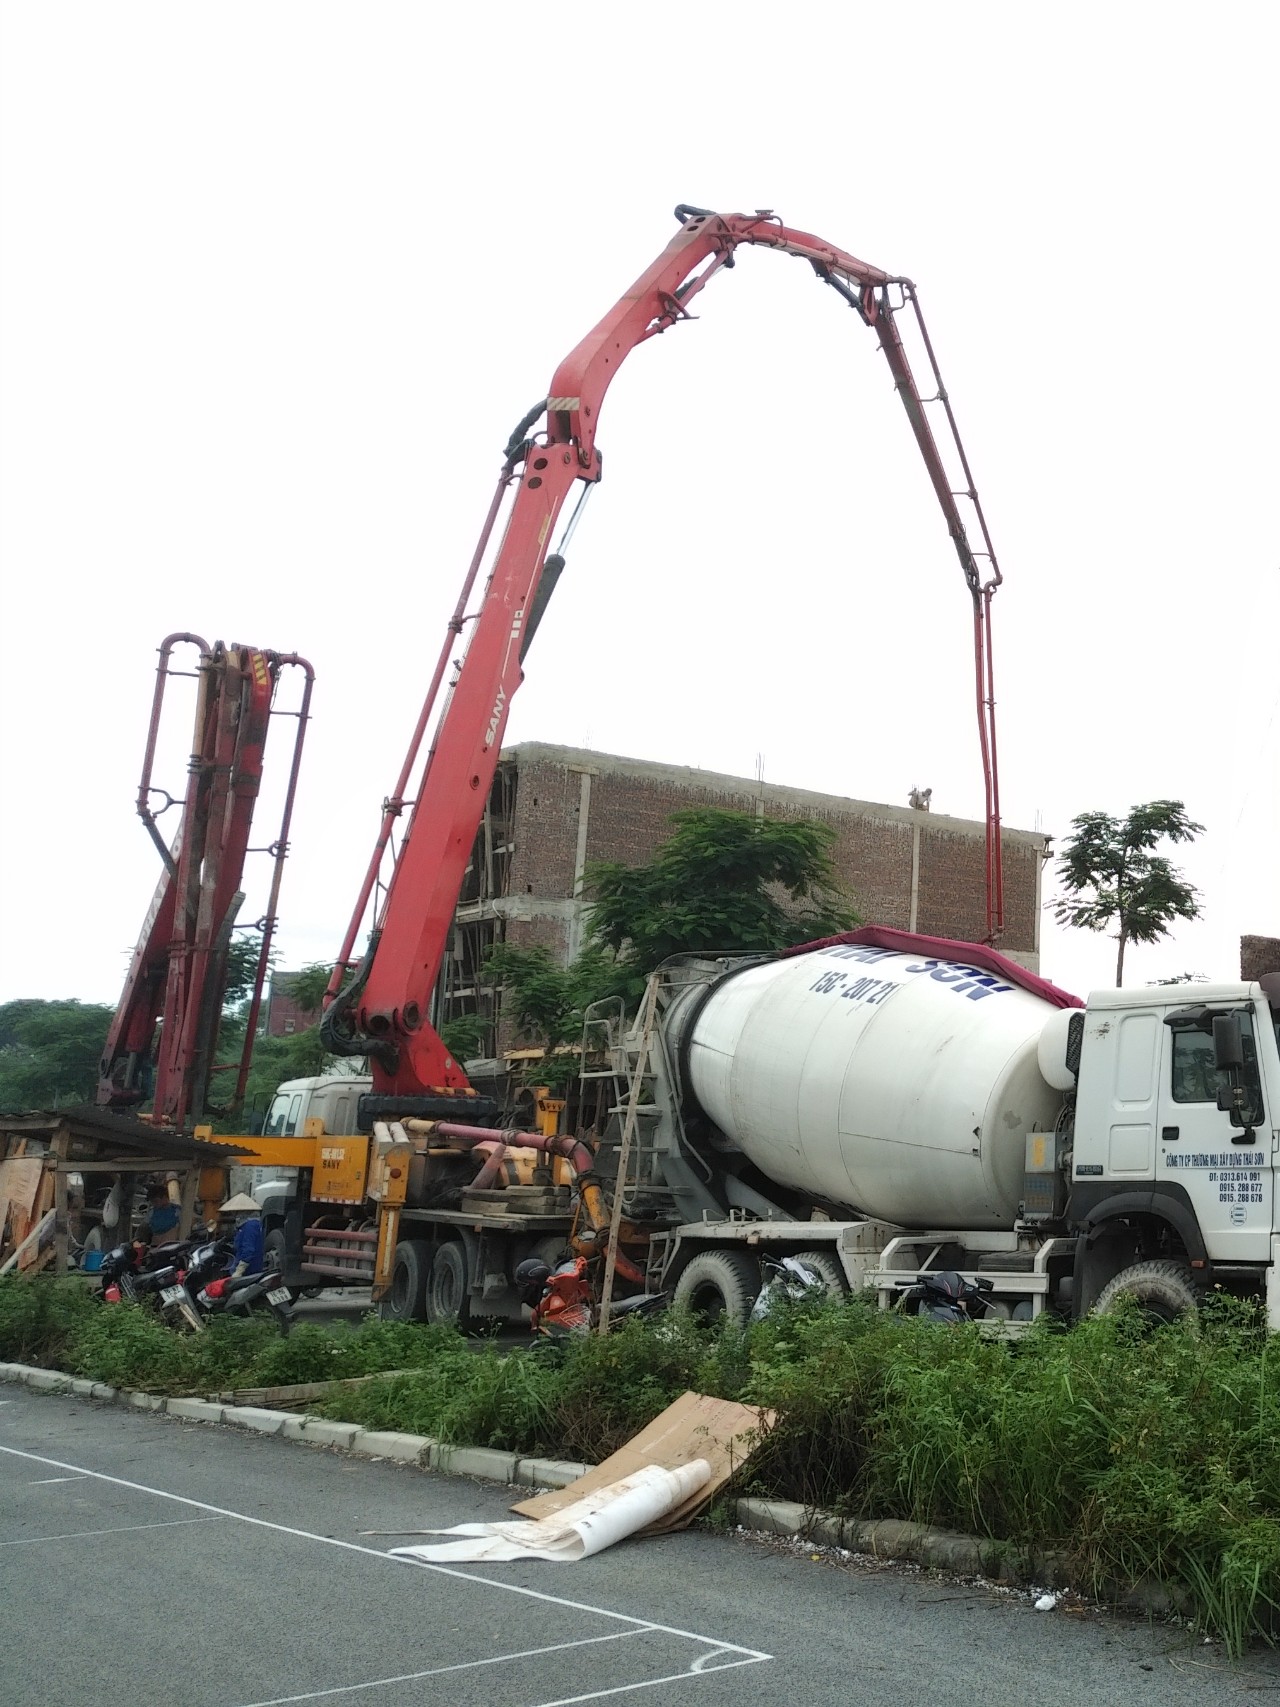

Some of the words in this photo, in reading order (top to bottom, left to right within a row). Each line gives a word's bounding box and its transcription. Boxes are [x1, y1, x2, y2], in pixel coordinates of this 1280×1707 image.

[485, 684, 507, 747] SANY
[322, 1160, 341, 1170] SANY
[1250, 1182, 1263, 1192] 677
[1250, 1193, 1263, 1203] 678
